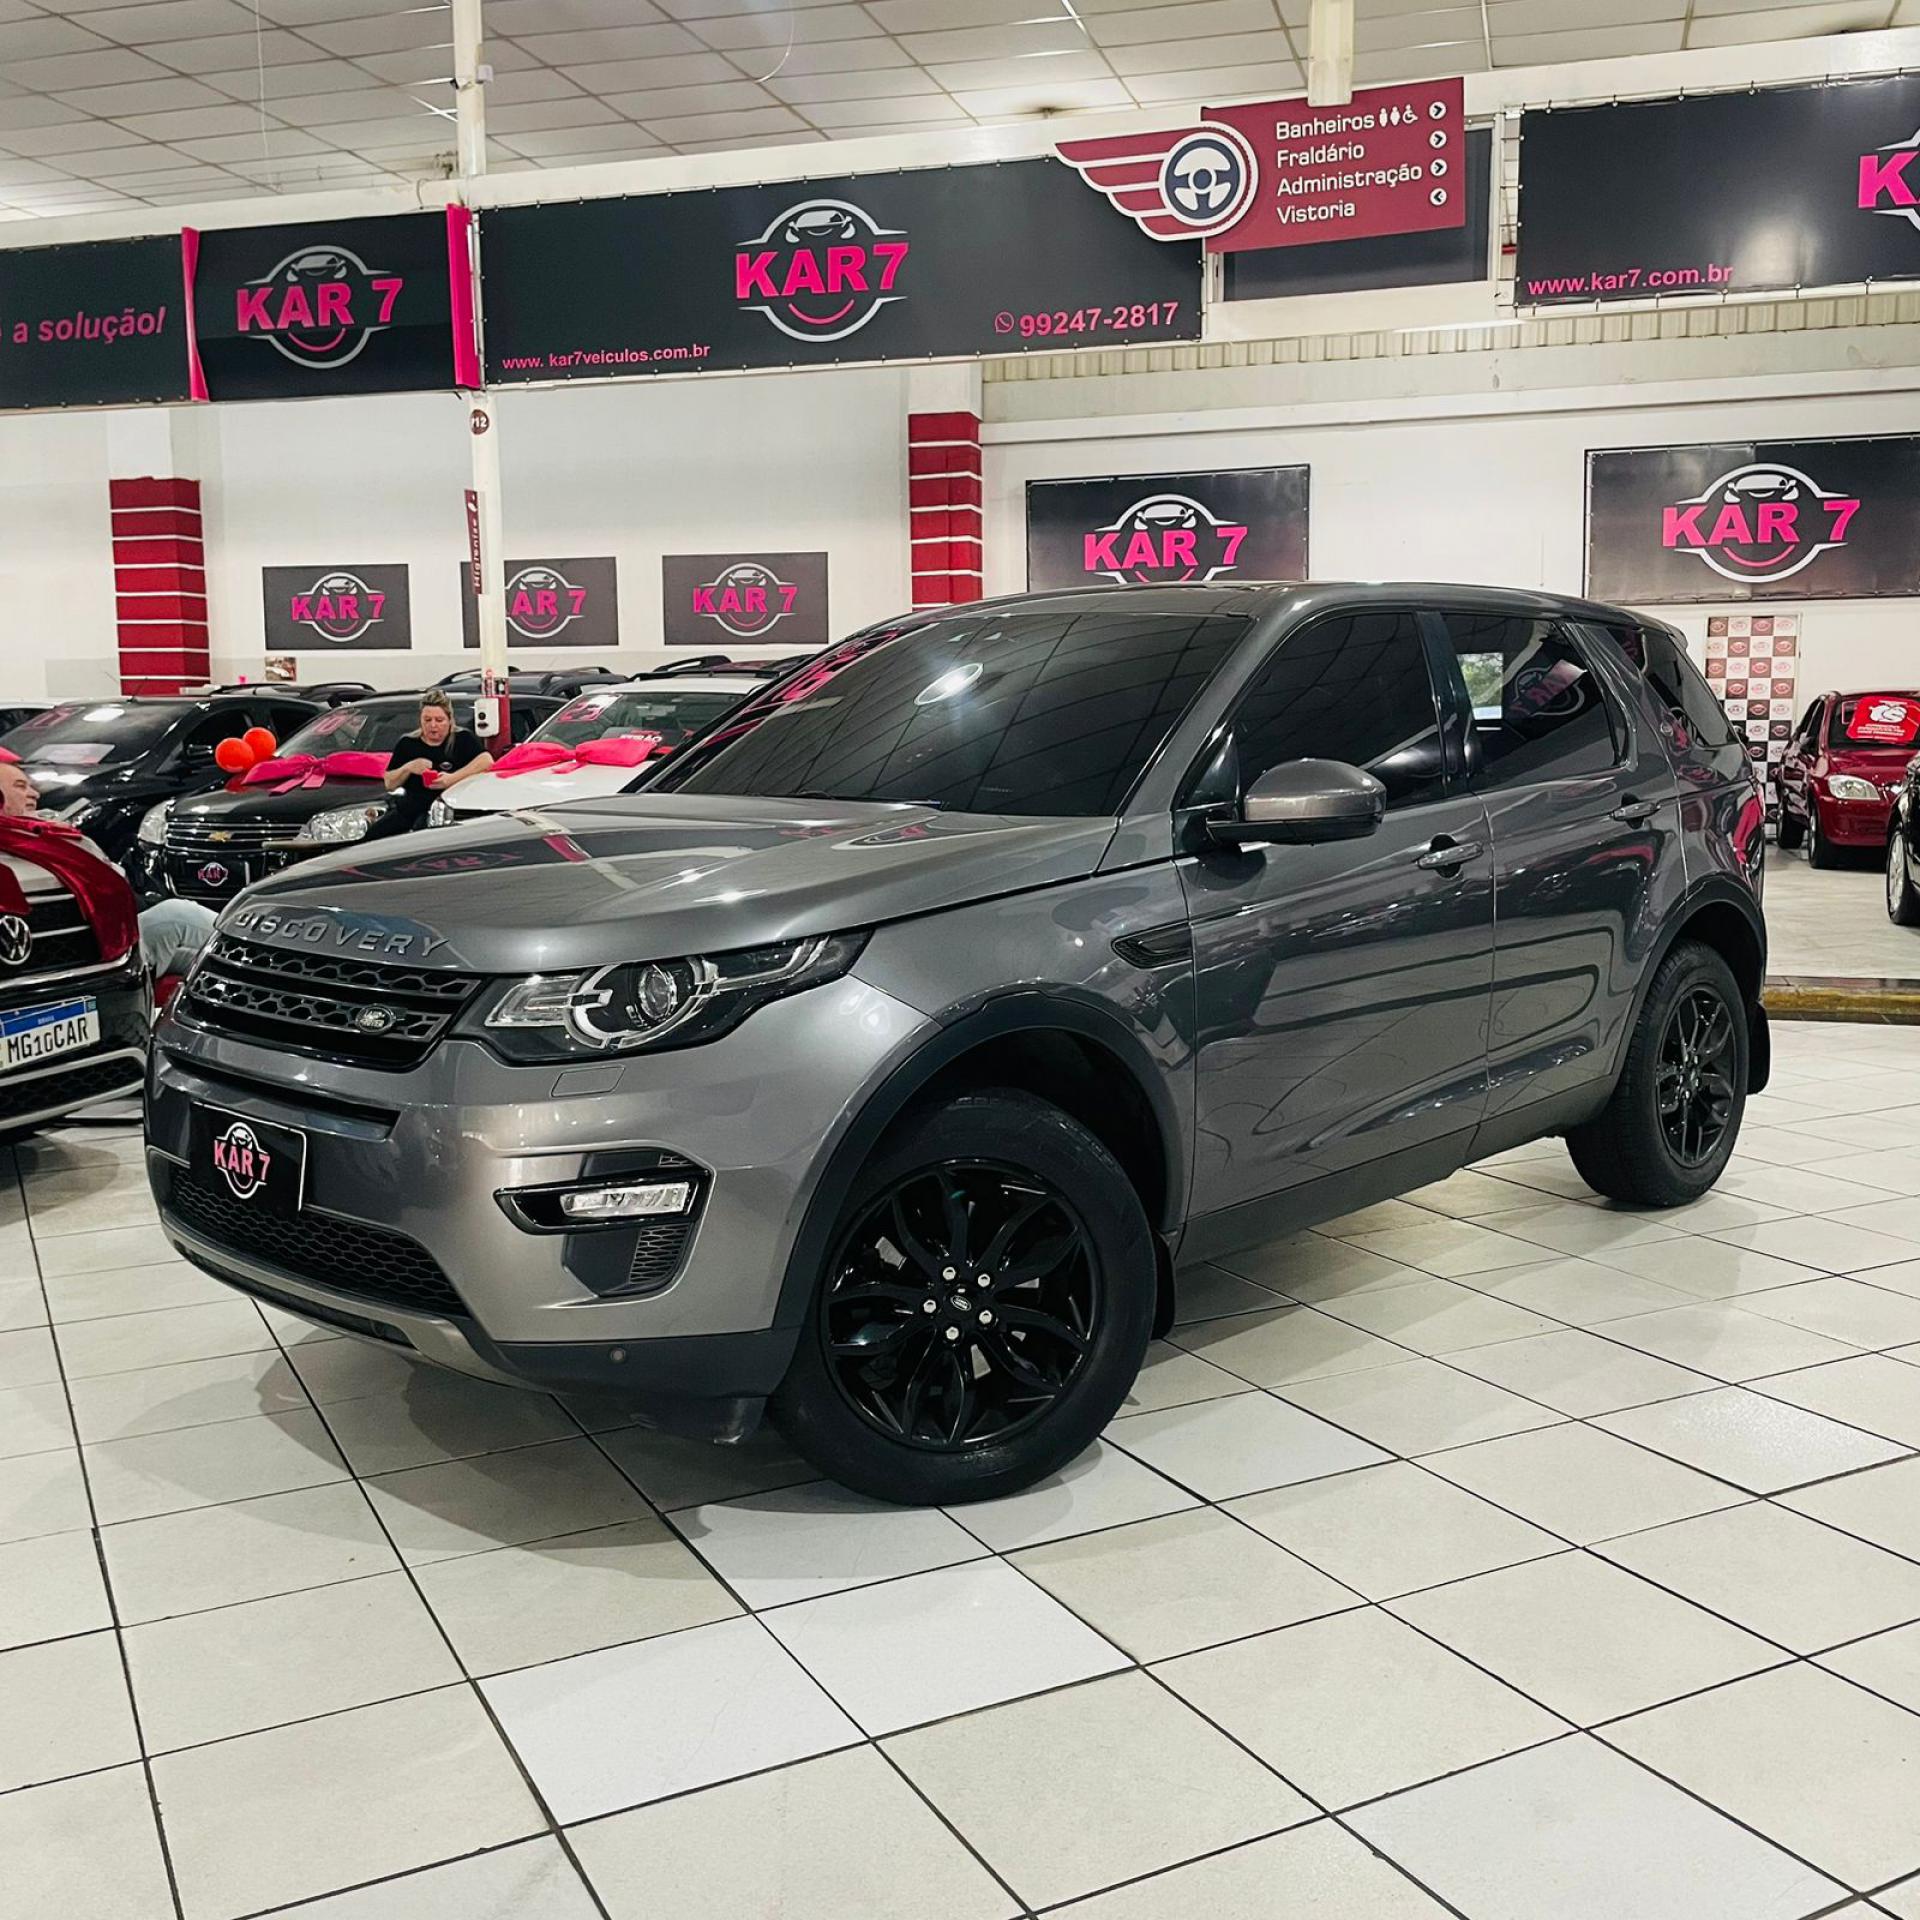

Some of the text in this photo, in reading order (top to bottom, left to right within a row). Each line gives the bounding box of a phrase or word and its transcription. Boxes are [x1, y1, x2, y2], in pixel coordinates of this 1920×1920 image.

[1276, 114, 1375, 140] Banheiros
[1277, 141, 1365, 168] Fraldário
[1277, 164, 1422, 197] Administração
[1858, 151, 1920, 208] K
[1277, 200, 1356, 224] Vistoria
[1528, 264, 1734, 295] www.kar7.com.br
[237, 278, 404, 331] KAR 7
[1019, 302, 1179, 337] 99247-2817
[13, 322, 28, 343] a
[1662, 498, 1862, 549] KAR 7
[1084, 526, 1248, 572] KAR 7
[290, 593, 386, 621] KAR 7
[506, 588, 587, 617] AR 7
[692, 585, 799, 614] KAR 7
[234, 912, 450, 957] DISCOVERY
[7, 1016, 89, 1064] MG10CAR
[213, 1139, 271, 1181] KAR 7
